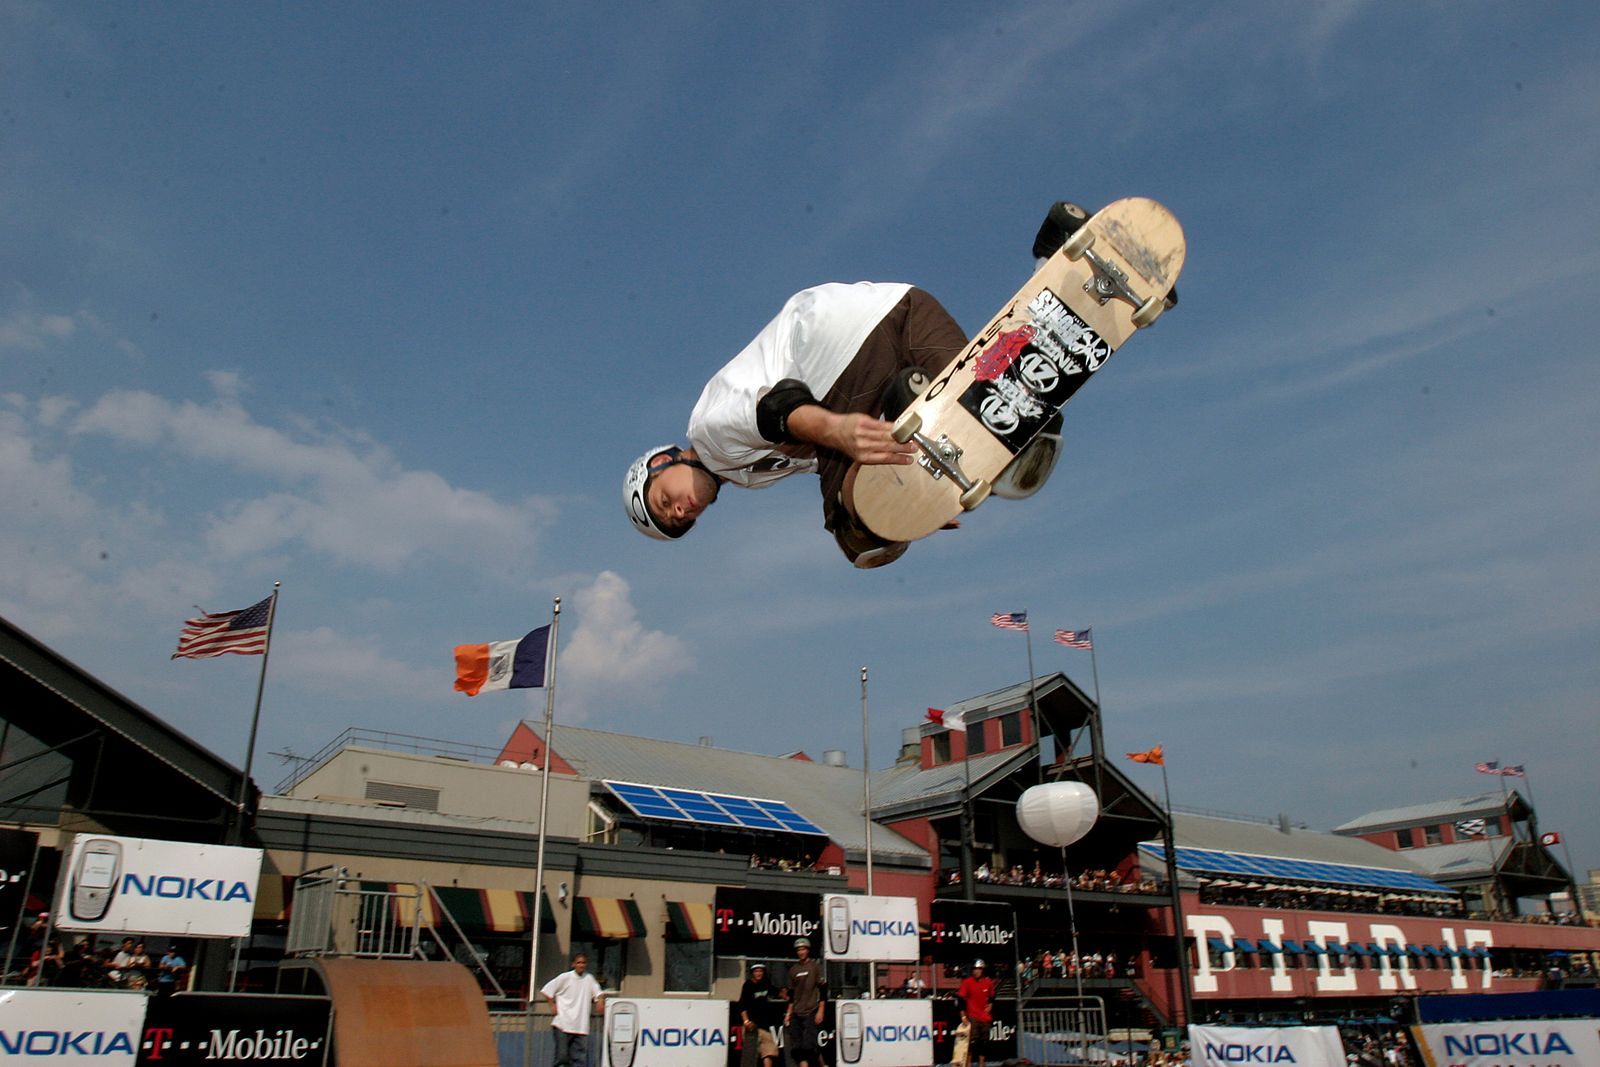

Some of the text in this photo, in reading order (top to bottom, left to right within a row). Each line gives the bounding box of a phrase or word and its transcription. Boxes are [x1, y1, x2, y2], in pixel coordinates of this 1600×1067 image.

[925, 300, 1018, 401] OAKLEY
[121, 873, 252, 902] NOKIA
[852, 920, 917, 936] NOKIA
[1187, 914, 1495, 992] PIER 17
[0, 1030, 135, 1056] NOKIA
[641, 1028, 726, 1047] NOKIA
[865, 1025, 932, 1042] NOKIA
[1443, 1032, 1575, 1056] NOKIA
[1206, 1042, 1296, 1063] NOKIA
